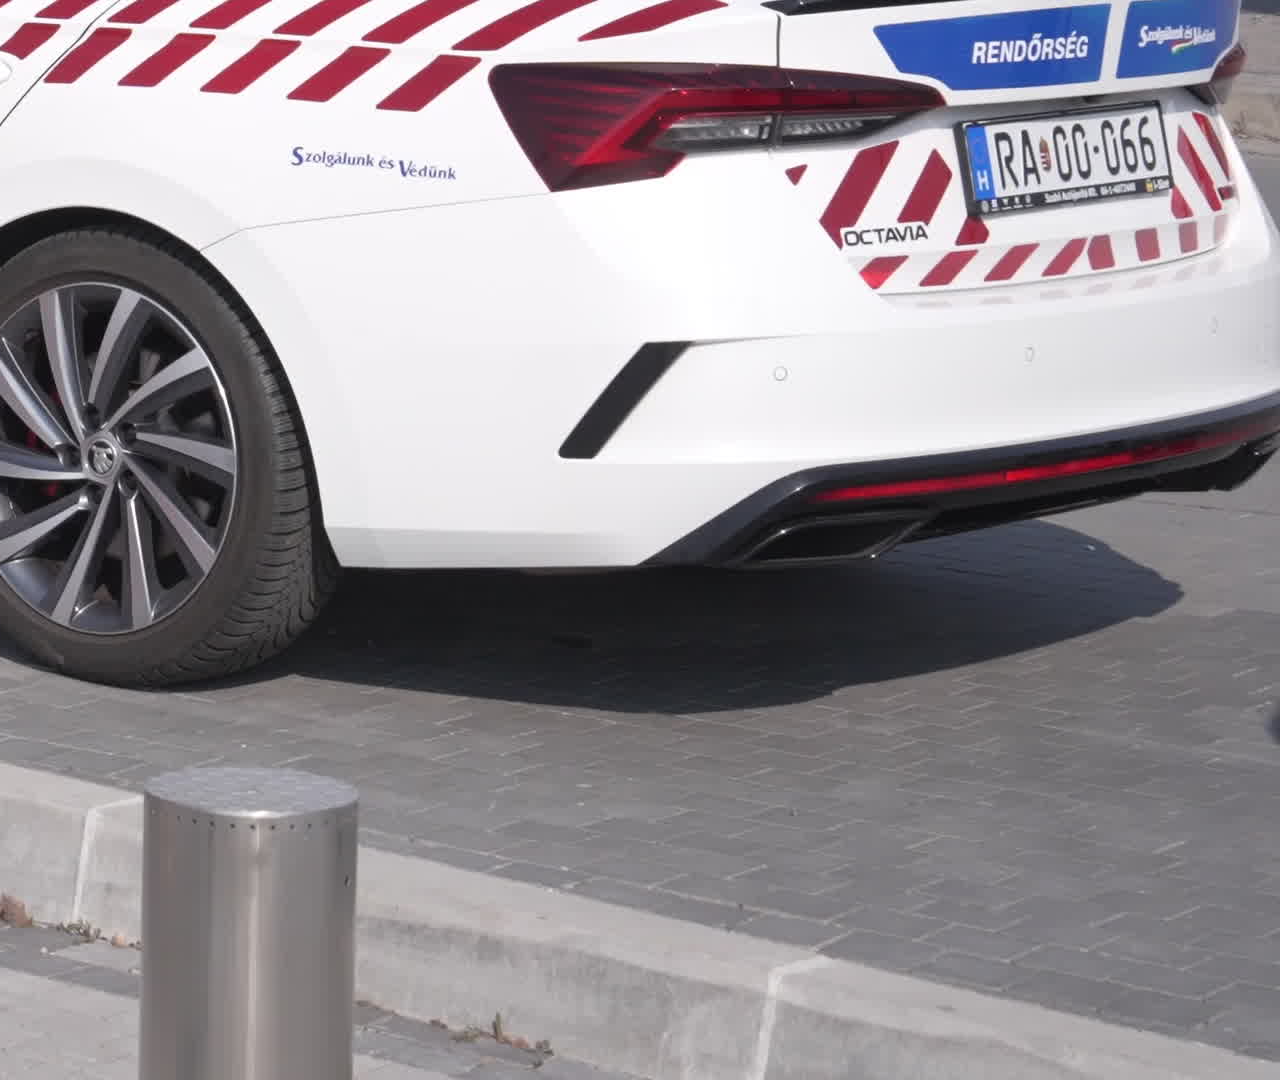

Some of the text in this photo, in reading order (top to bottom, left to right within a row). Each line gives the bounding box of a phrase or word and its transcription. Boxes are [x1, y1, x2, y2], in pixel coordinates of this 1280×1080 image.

[971, 31, 1088, 64] RENDŐRSÉG
[291, 146, 374, 167] Szolgálunk
[378, 156, 394, 169] és
[994, 129, 1041, 191] RA
[976, 170, 990, 192] H
[844, 225, 928, 246] OCTAVIA
